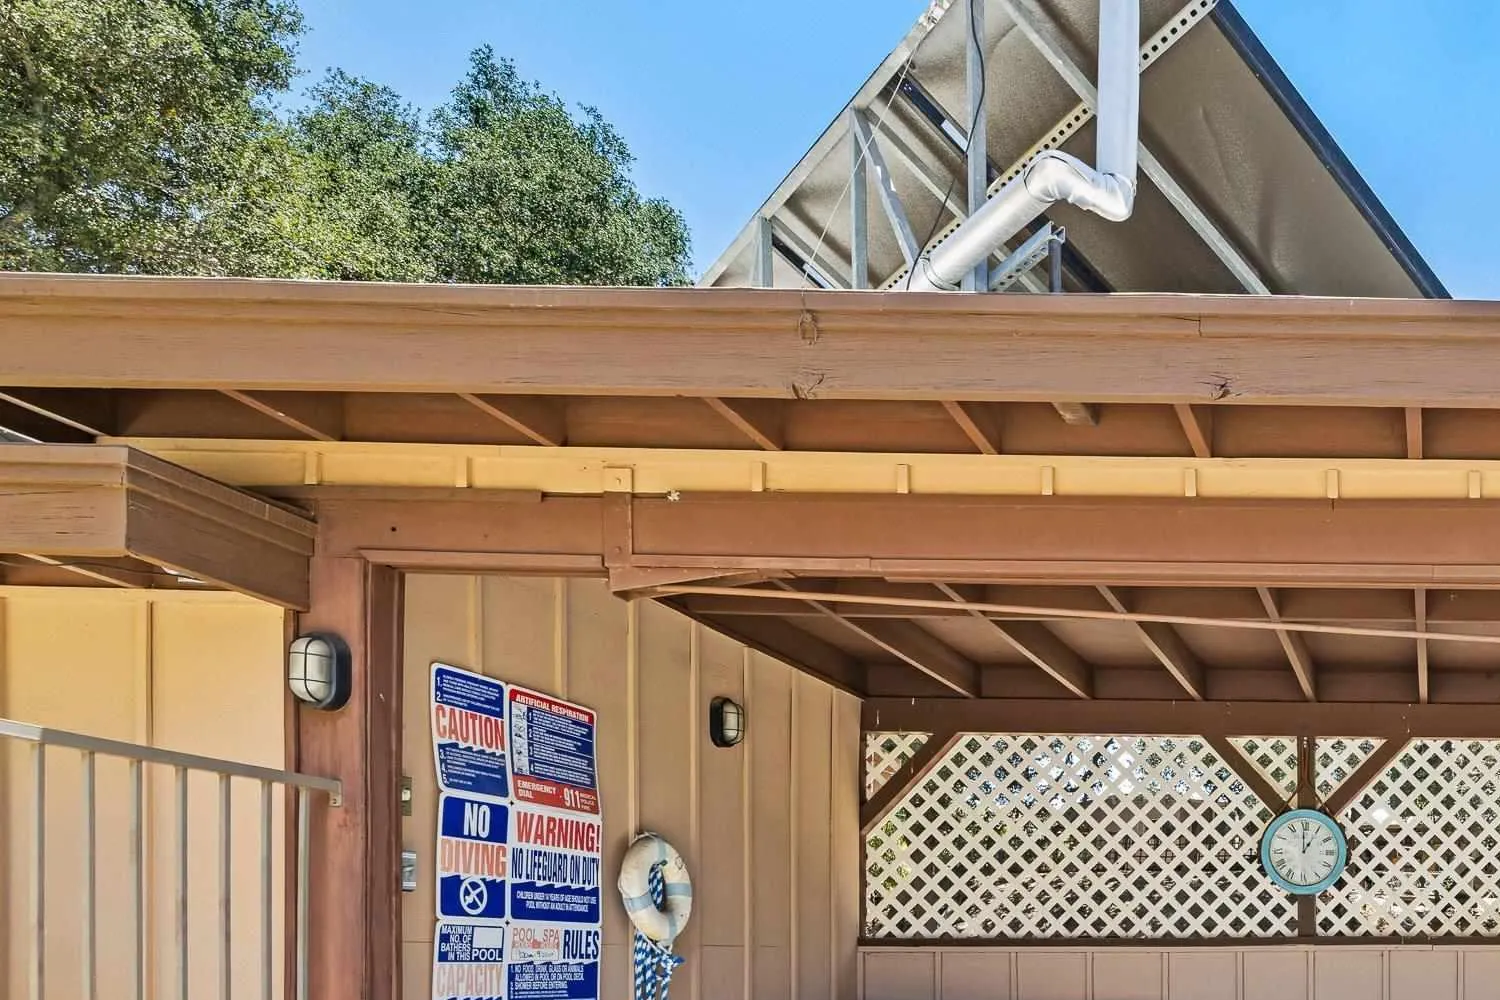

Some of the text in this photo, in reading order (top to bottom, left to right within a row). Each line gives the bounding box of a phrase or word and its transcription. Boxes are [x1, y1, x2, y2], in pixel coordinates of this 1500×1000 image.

[516, 694, 551, 711] ARTIFICIAL
[551, 704, 589, 723] RESPIRATION
[435, 704, 505, 750] CAUTION
[517, 780, 556, 795] EMERGENCY
[518, 788, 534, 799] DIAL
[563, 787, 580, 809] 911
[463, 801, 491, 839] NO
[516, 811, 601, 853] WARNING!
[440, 838, 507, 878] DIVING
[511, 847, 600, 886] NO LIFEGUARD ON DUTY
[441, 925, 473, 935] MAXIMUM
[462, 934, 472, 944] OF
[543, 928, 560, 943] SPA
[563, 929, 600, 960] RULES
[441, 943, 471, 952] BATHERS
[447, 948, 502, 961] IN THIS POOL
[436, 965, 503, 997] CAPACITY
